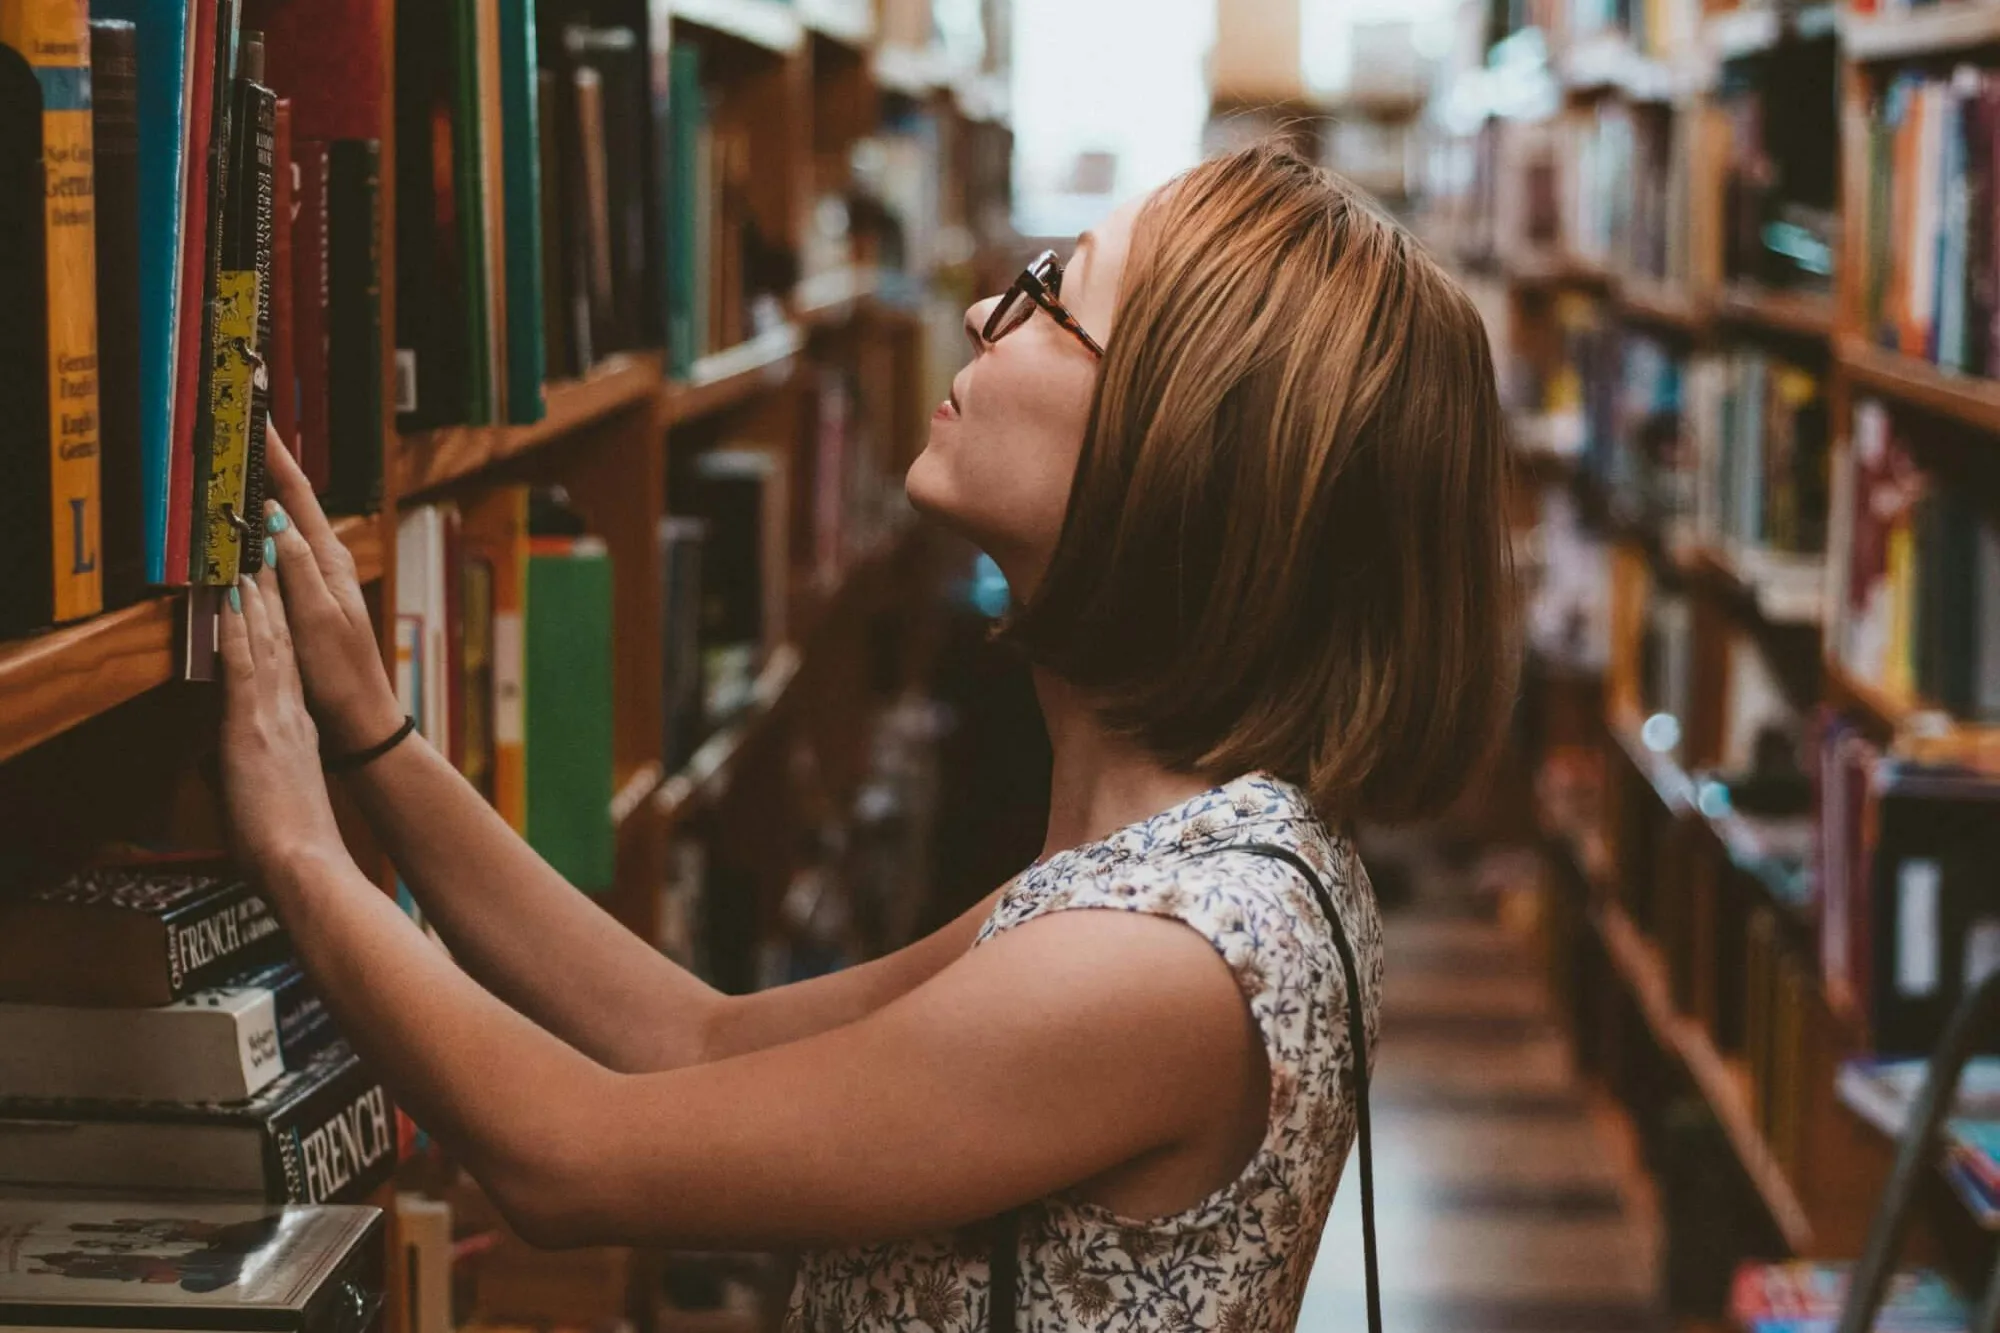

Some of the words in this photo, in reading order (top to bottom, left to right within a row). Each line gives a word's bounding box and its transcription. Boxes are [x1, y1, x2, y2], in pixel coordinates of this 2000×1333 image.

[69, 498, 95, 574] L
[179, 904, 240, 974] FRENCH
[301, 1084, 391, 1205] FRENCH
